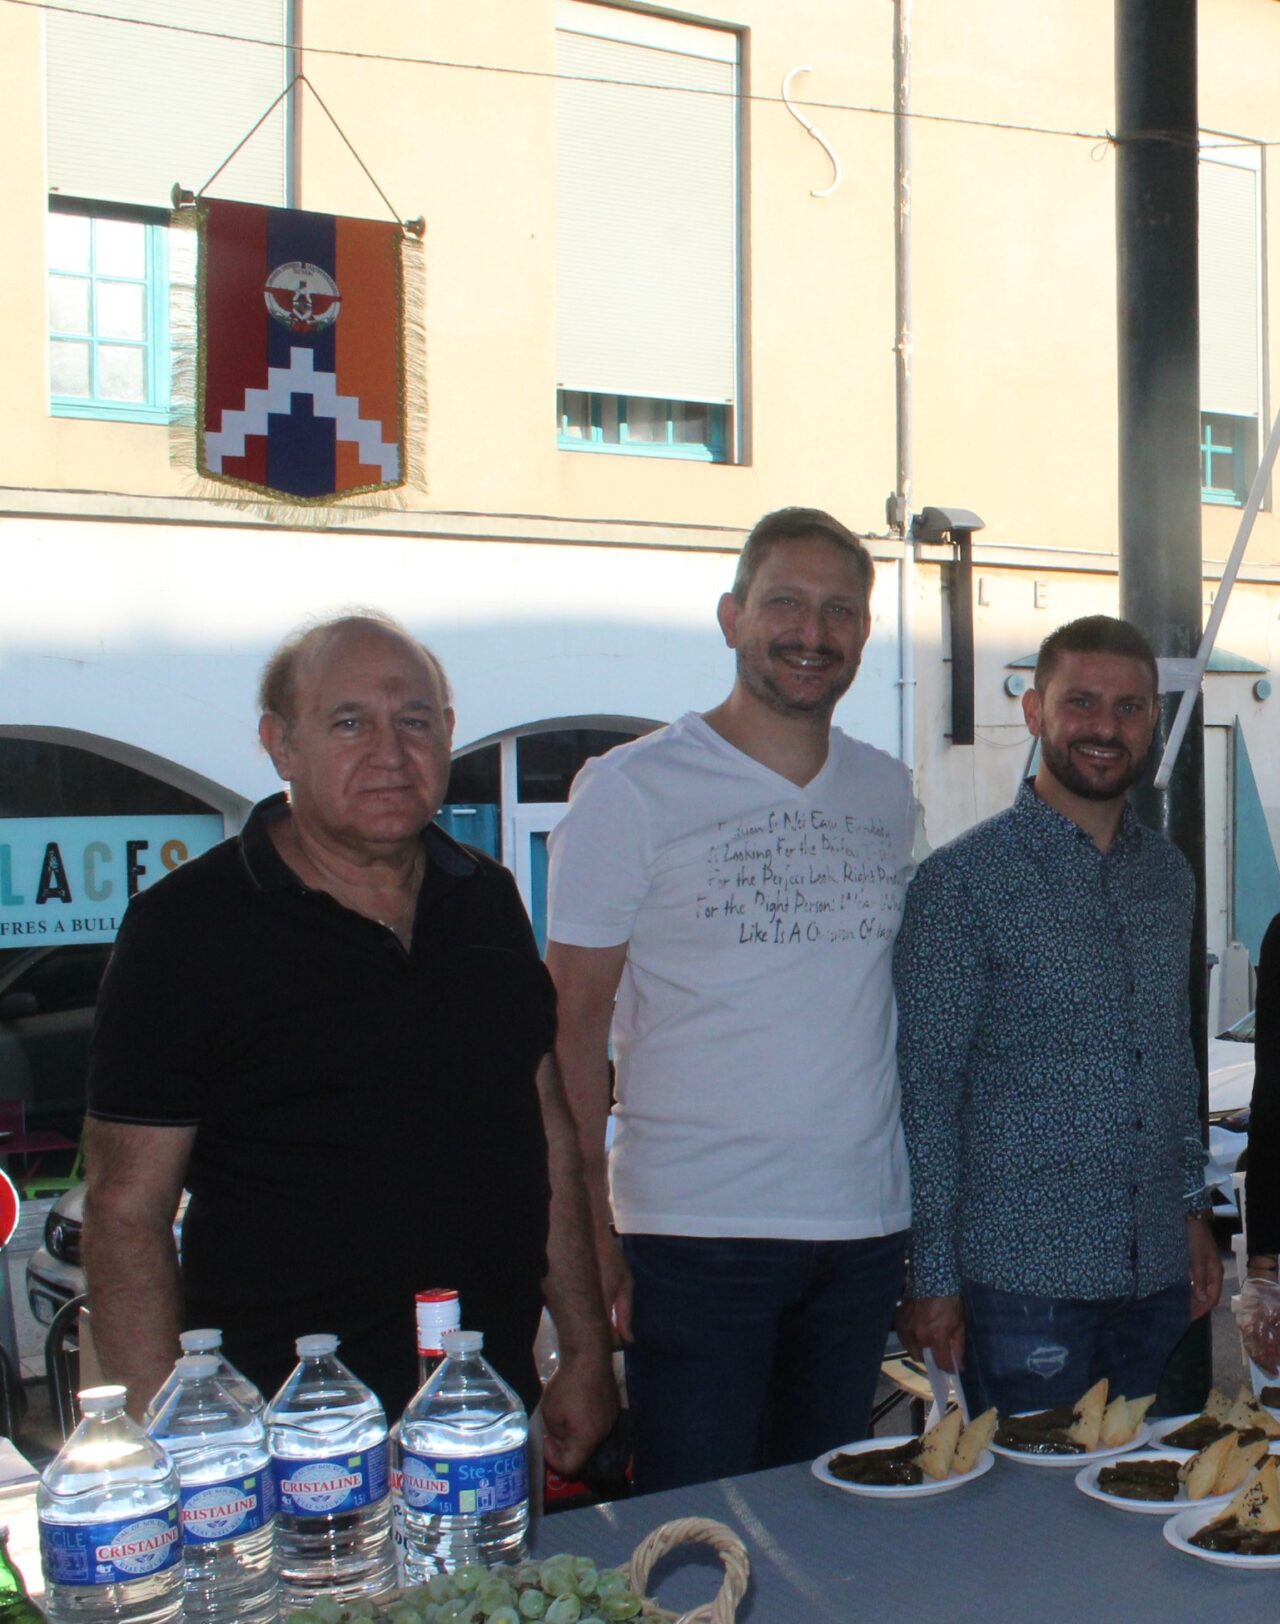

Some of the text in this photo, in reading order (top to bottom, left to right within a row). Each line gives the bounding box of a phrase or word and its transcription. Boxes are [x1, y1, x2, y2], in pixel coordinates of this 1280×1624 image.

[724, 843, 772, 867] Looking
[776, 836, 796, 858] For
[736, 865, 756, 887] the
[844, 861, 874, 884] Right
[725, 893, 745, 916] the
[54, 920, 65, 933] A
[740, 921, 767, 943] Like
[774, 918, 785, 944] Is
[789, 922, 801, 944] A
[282, 1475, 360, 1492] CRISTALINE
[180, 1498, 255, 1521] RISTALINE
[98, 1529, 177, 1560] CRISTALINE
